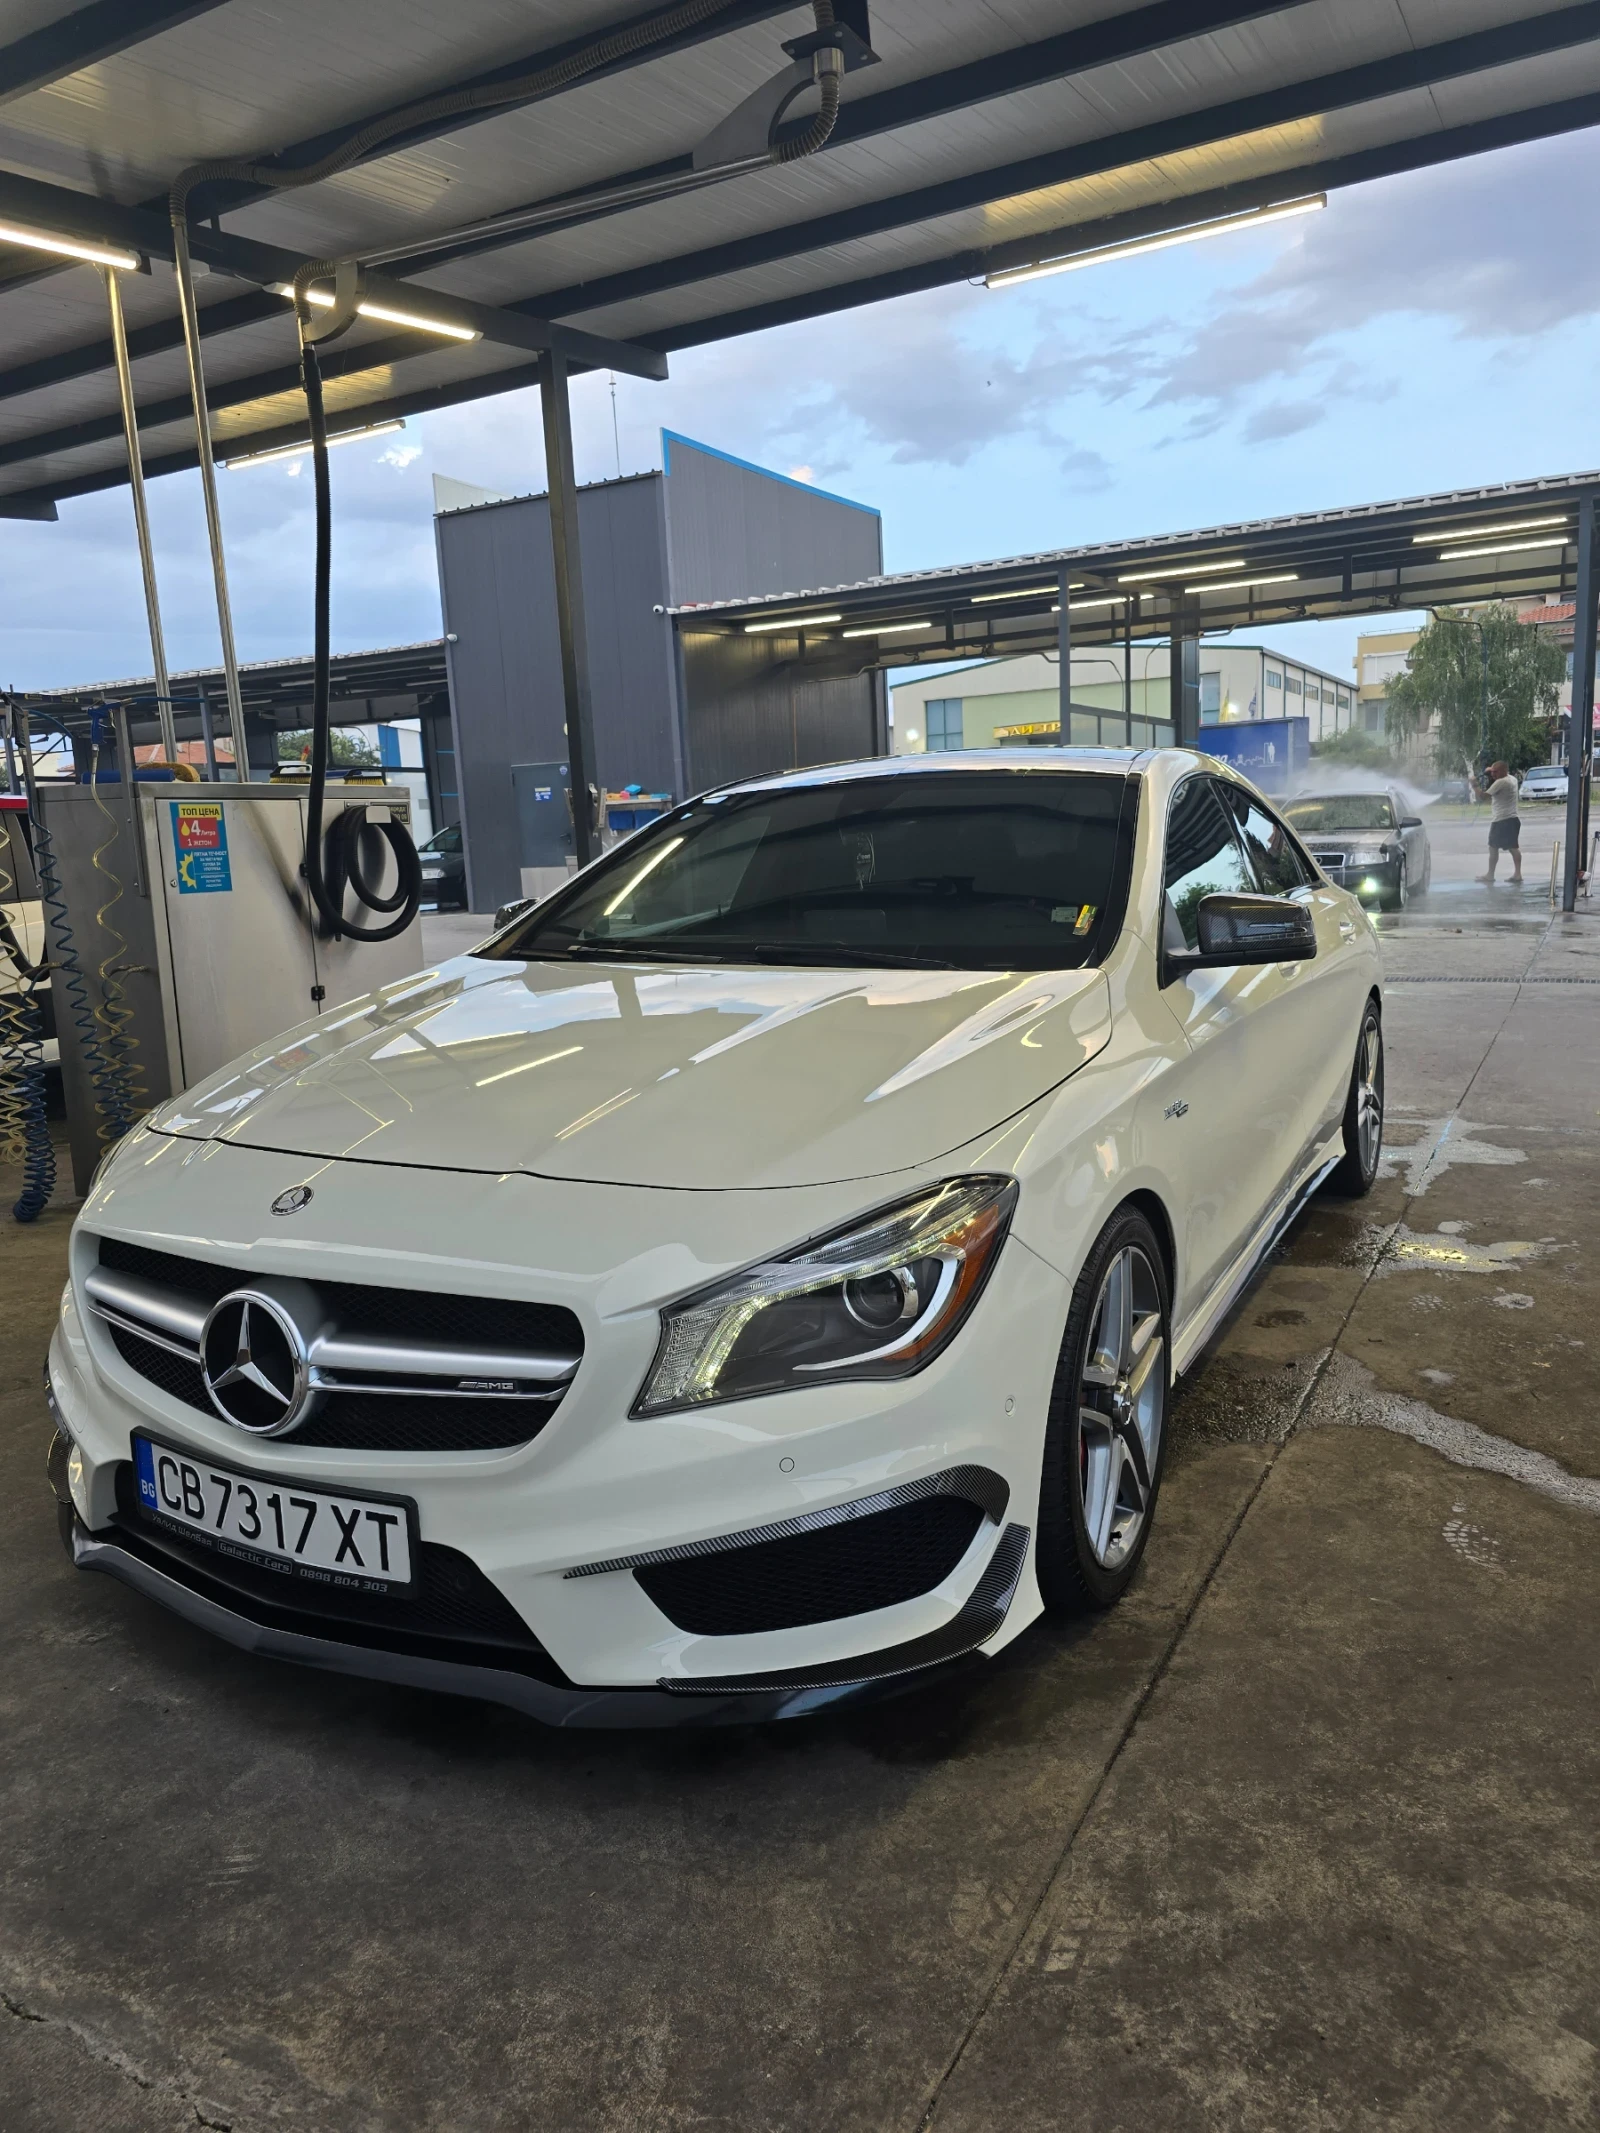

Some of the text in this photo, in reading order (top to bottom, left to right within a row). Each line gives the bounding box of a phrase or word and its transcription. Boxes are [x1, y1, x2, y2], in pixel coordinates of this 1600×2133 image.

[181, 808, 220, 817] ТОП ЦЕНА
[191, 819, 201, 836] 4
[187, 838, 193, 847] 1
[476, 1381, 514, 1390] AMG
[141, 1478, 156, 1499] BG
[219, 1542, 291, 1573] Galactic Cars
[300, 1567, 389, 1594] 0898 804 303
